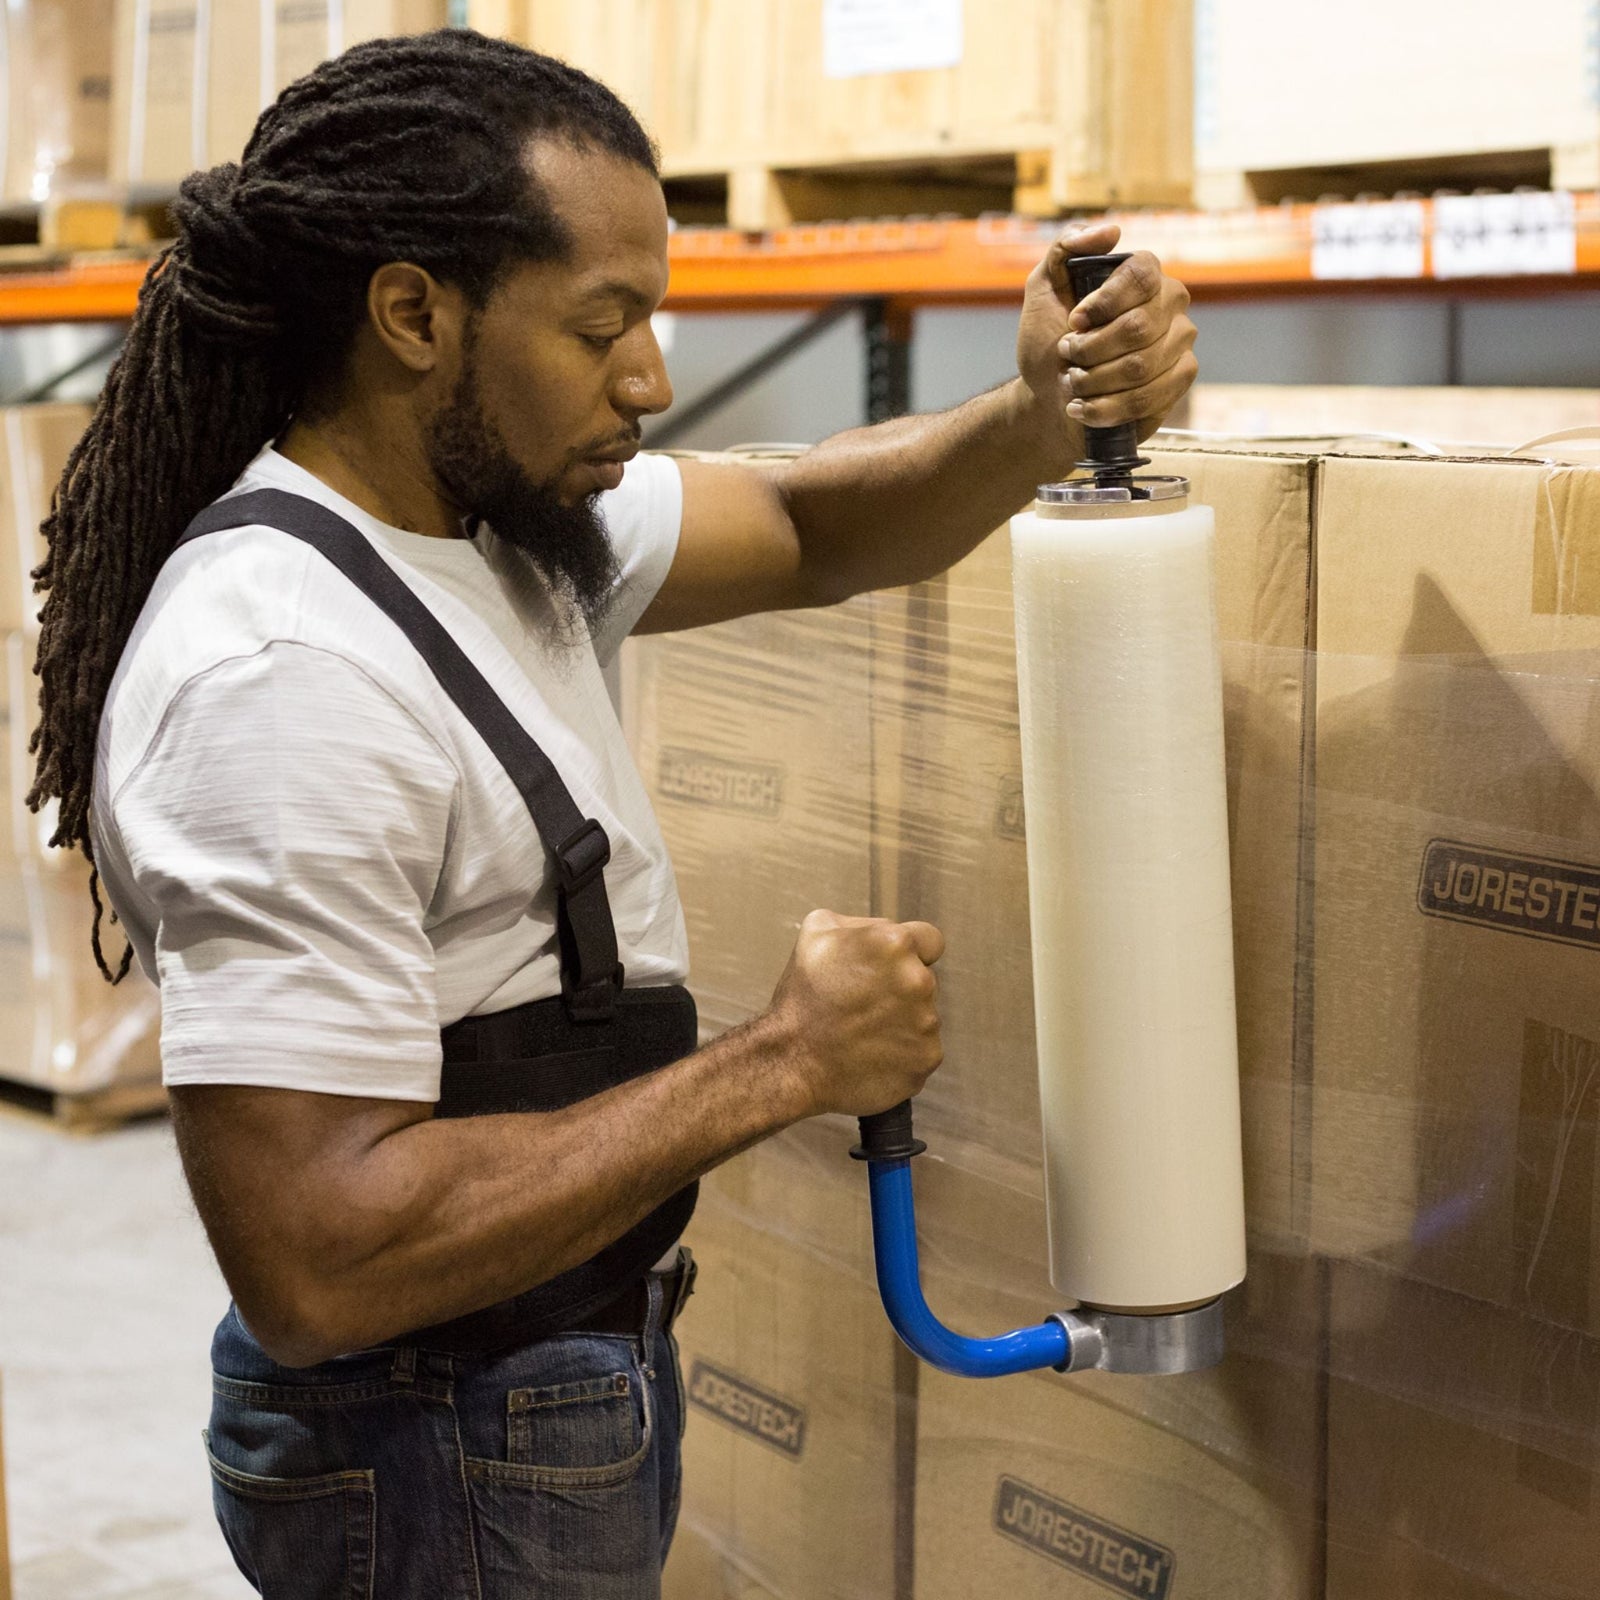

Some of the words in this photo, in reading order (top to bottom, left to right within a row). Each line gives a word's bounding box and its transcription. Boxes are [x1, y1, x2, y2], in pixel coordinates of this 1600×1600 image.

[1433, 859, 1600, 932] JORESTE
[692, 1371, 800, 1449] JORESTECH
[1003, 1494, 1161, 1594] JORESTECH
